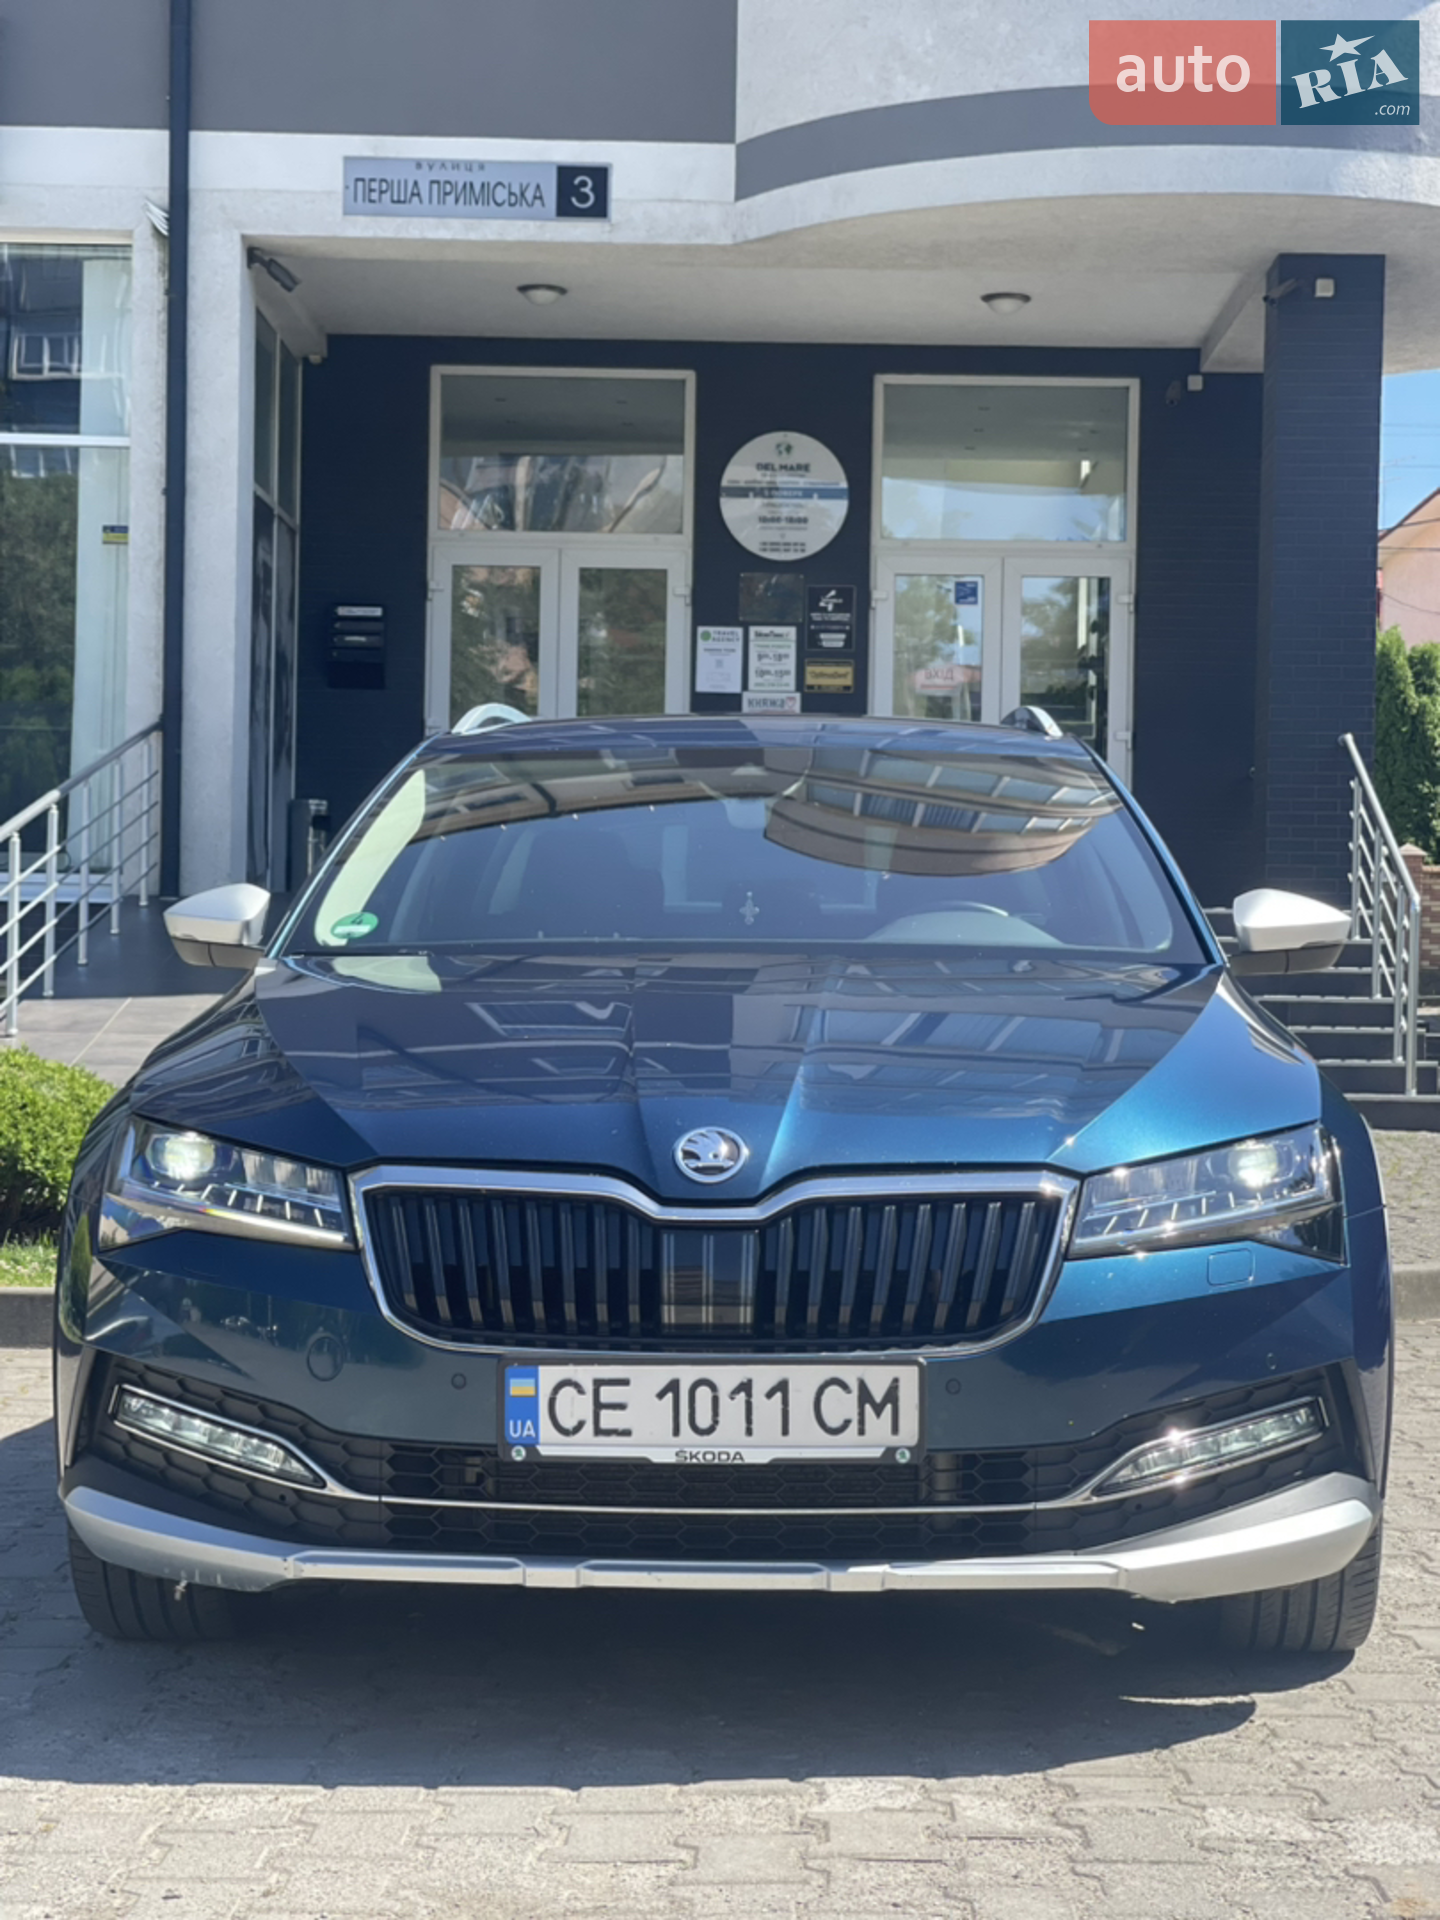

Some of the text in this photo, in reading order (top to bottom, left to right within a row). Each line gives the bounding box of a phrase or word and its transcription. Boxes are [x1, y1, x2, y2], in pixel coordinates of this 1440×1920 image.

[353, 177, 546, 208] ПЕРША ПРИМІСЬКА
[570, 175, 596, 209] 3
[548, 1376, 900, 1437] CE 1011 CM
[509, 1419, 536, 1439] UA
